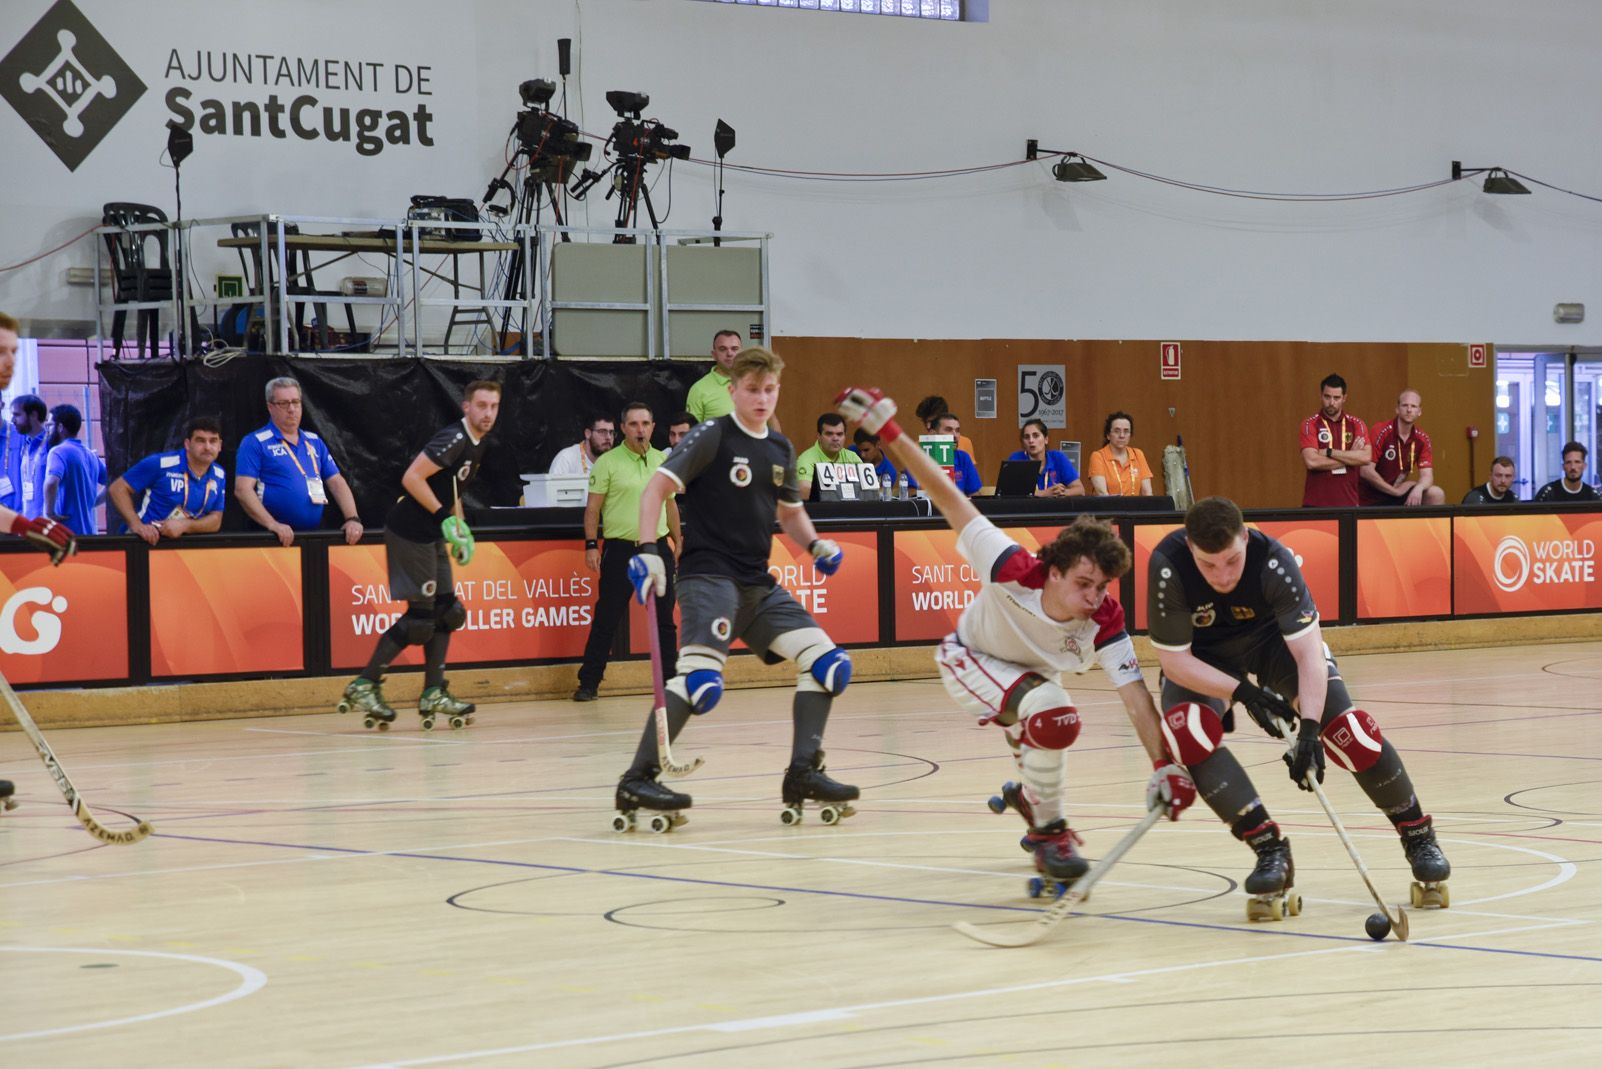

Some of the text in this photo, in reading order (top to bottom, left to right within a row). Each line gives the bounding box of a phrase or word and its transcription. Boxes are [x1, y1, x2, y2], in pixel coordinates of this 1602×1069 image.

[164, 48, 432, 96] AJUNTAMENT DE
[164, 86, 435, 157] SantCugat
[939, 444, 951, 463] T
[170, 478, 184, 493] VP
[823, 465, 834, 482] 4
[863, 467, 875, 487] 6
[1533, 539, 1595, 559] WORLD
[912, 564, 954, 584] SANT
[1533, 560, 1595, 584] SKATE
[352, 585, 400, 605] SAN
[483, 579, 517, 600] DEL
[524, 571, 592, 598] VALLÈS
[912, 590, 975, 611] WORLD
[521, 605, 592, 628] GAMES
